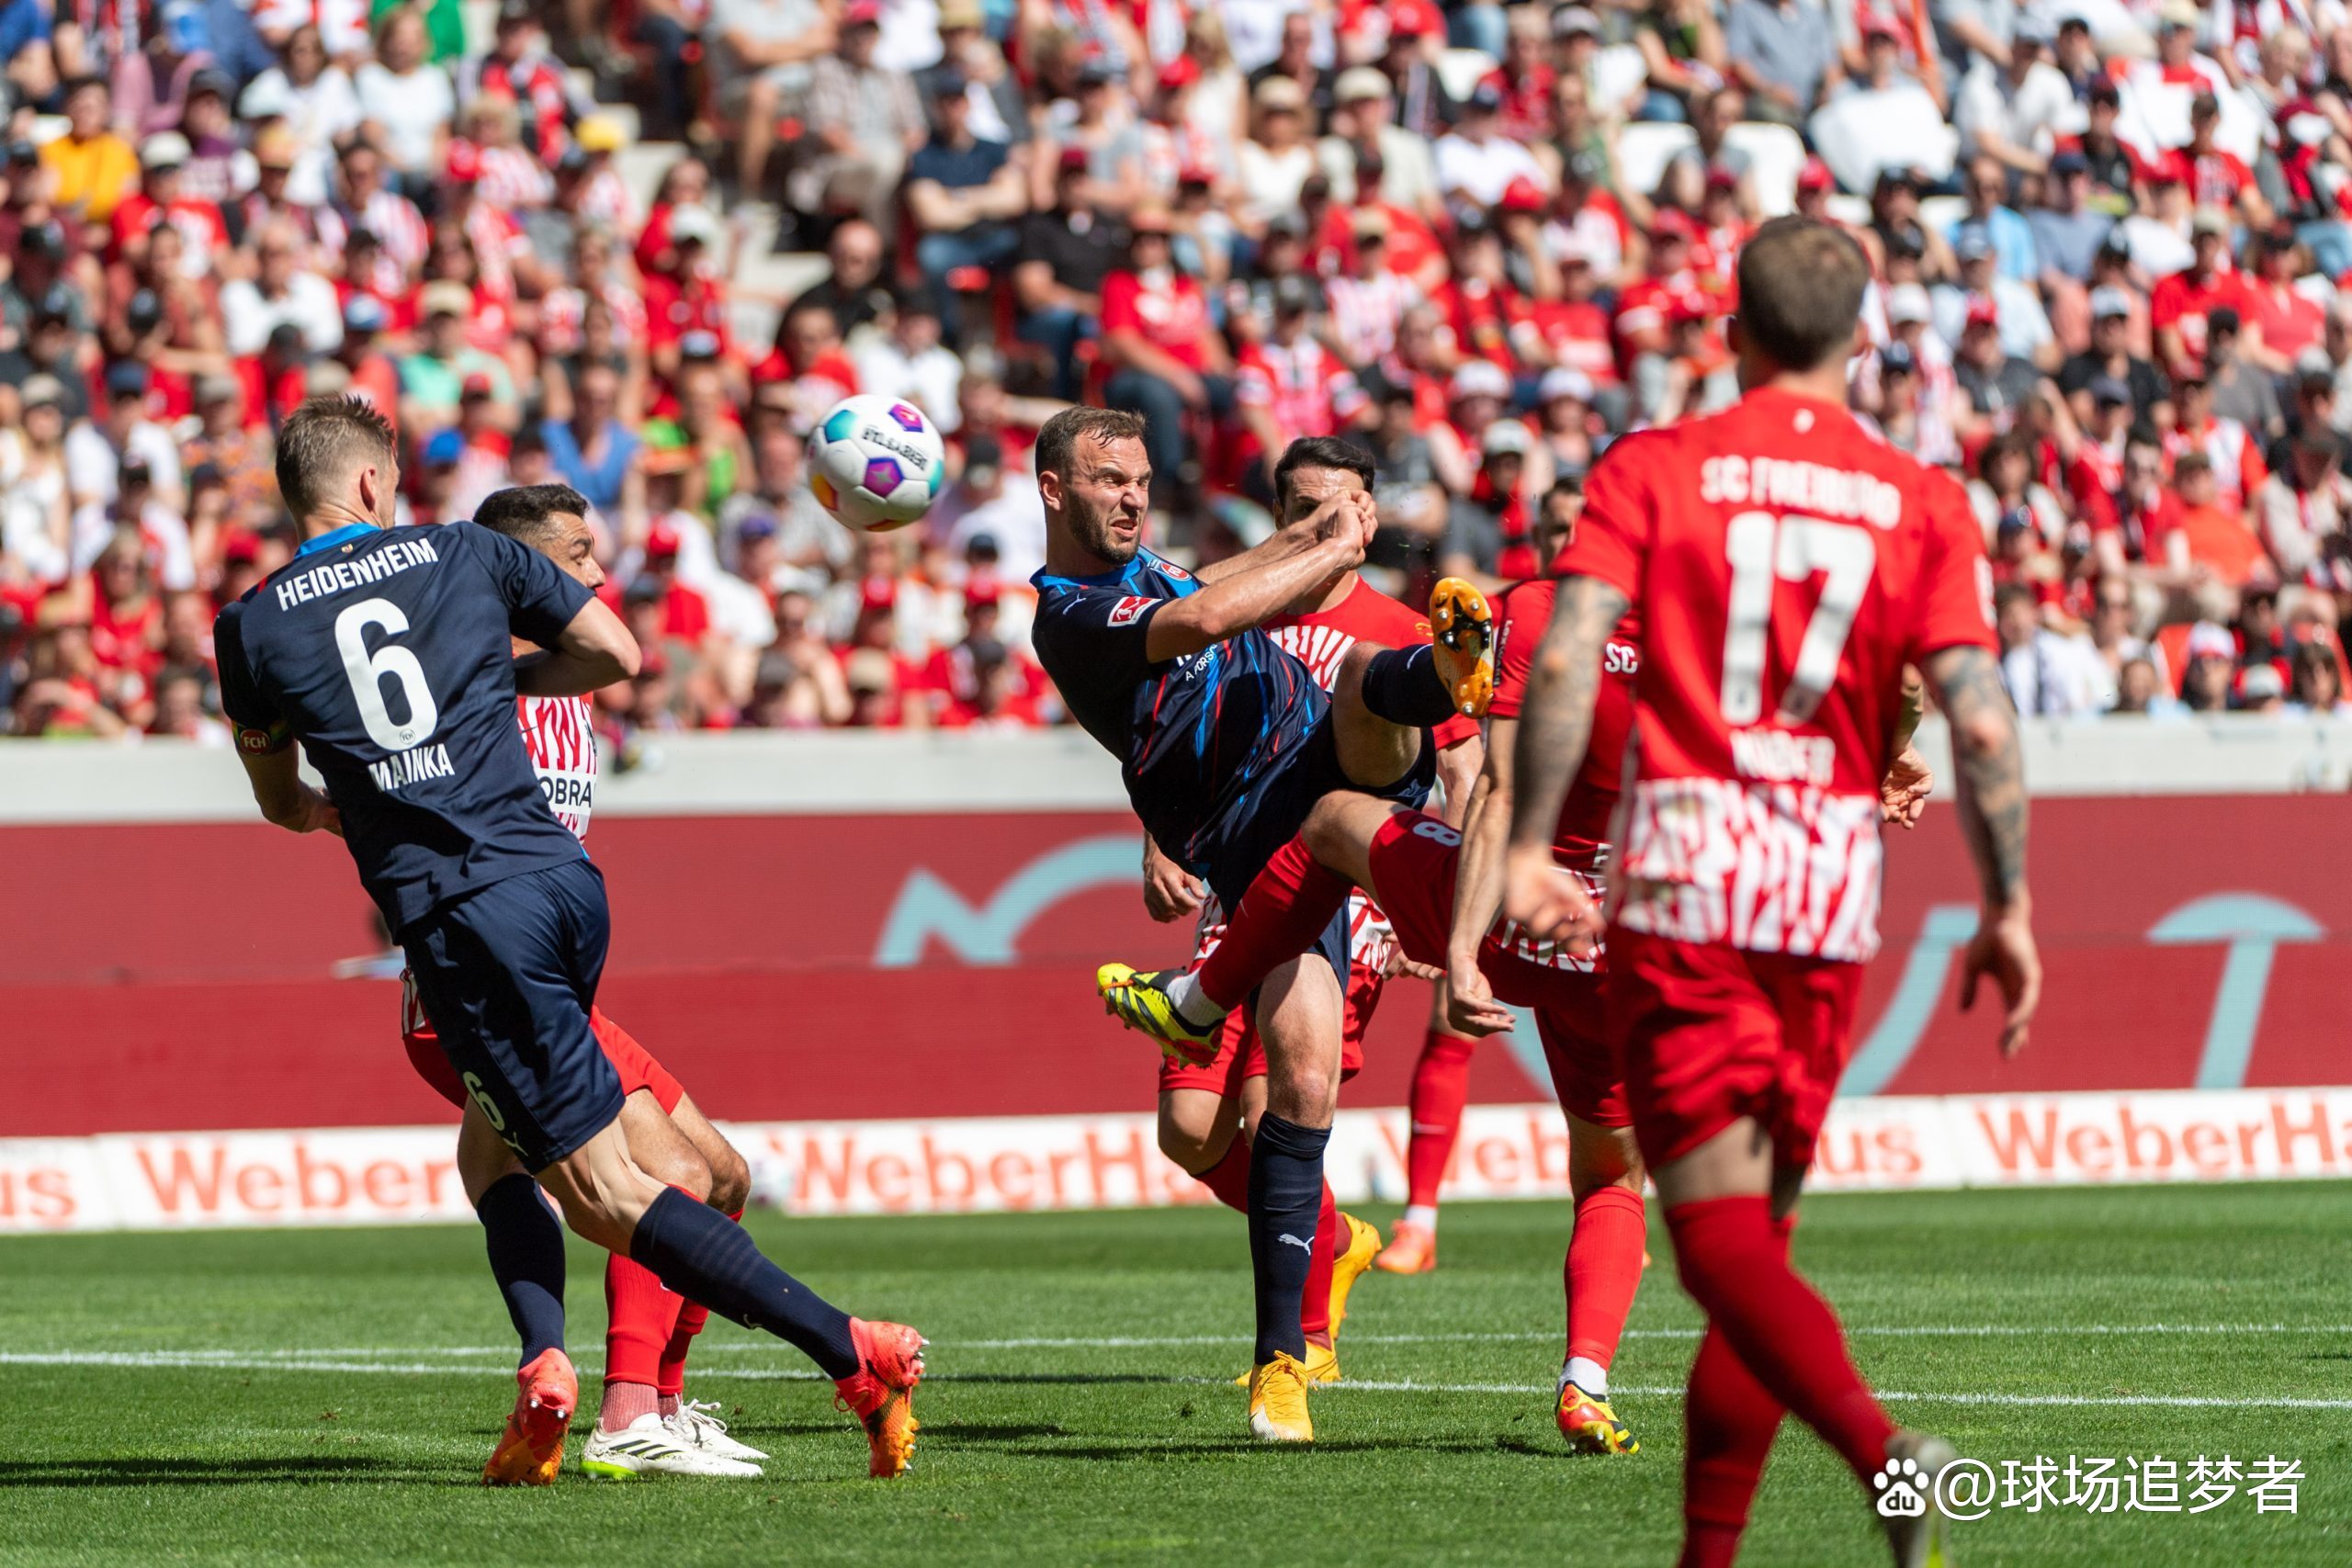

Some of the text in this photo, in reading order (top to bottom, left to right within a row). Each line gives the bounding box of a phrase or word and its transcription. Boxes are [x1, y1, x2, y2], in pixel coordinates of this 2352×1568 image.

[1701, 454, 1749, 504] SC
[276, 537, 439, 612] HEIDENHEIM
[1719, 511, 1876, 727] 17
[334, 597, 438, 751] 6
[1604, 642, 1638, 674] SC
[243, 736, 266, 749] FCH
[368, 743, 456, 793] MAINKA
[462, 1071, 505, 1132] 6
